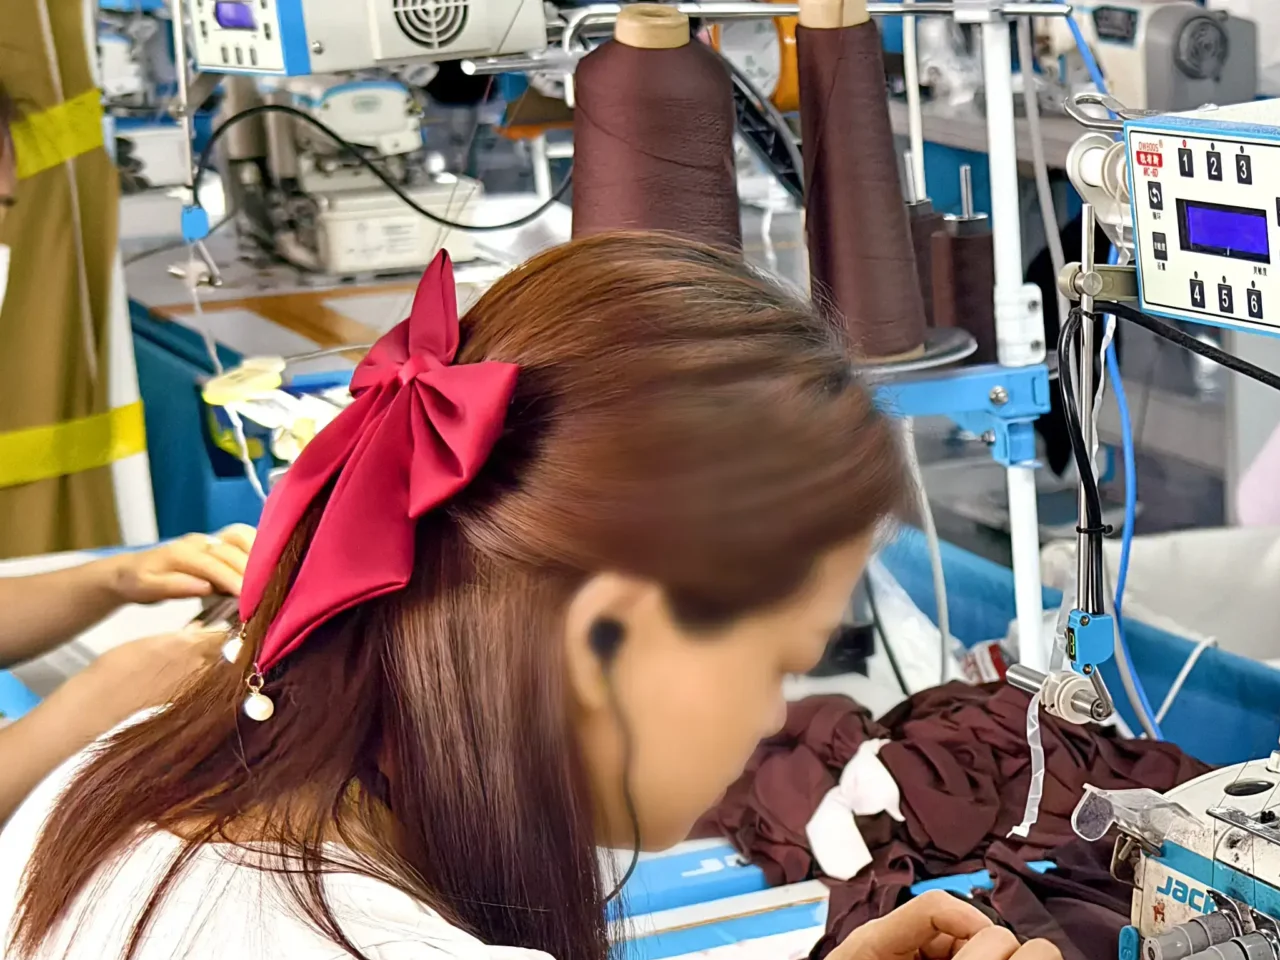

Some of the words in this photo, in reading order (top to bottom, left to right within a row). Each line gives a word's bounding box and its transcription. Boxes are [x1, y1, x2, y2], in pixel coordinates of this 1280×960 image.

[1182, 154, 1189, 171] 1
[1210, 157, 1218, 176] 2
[1240, 160, 1247, 178] 3
[1193, 285, 1201, 302] 4
[1222, 290, 1229, 307] 5
[1251, 295, 1258, 312] 6
